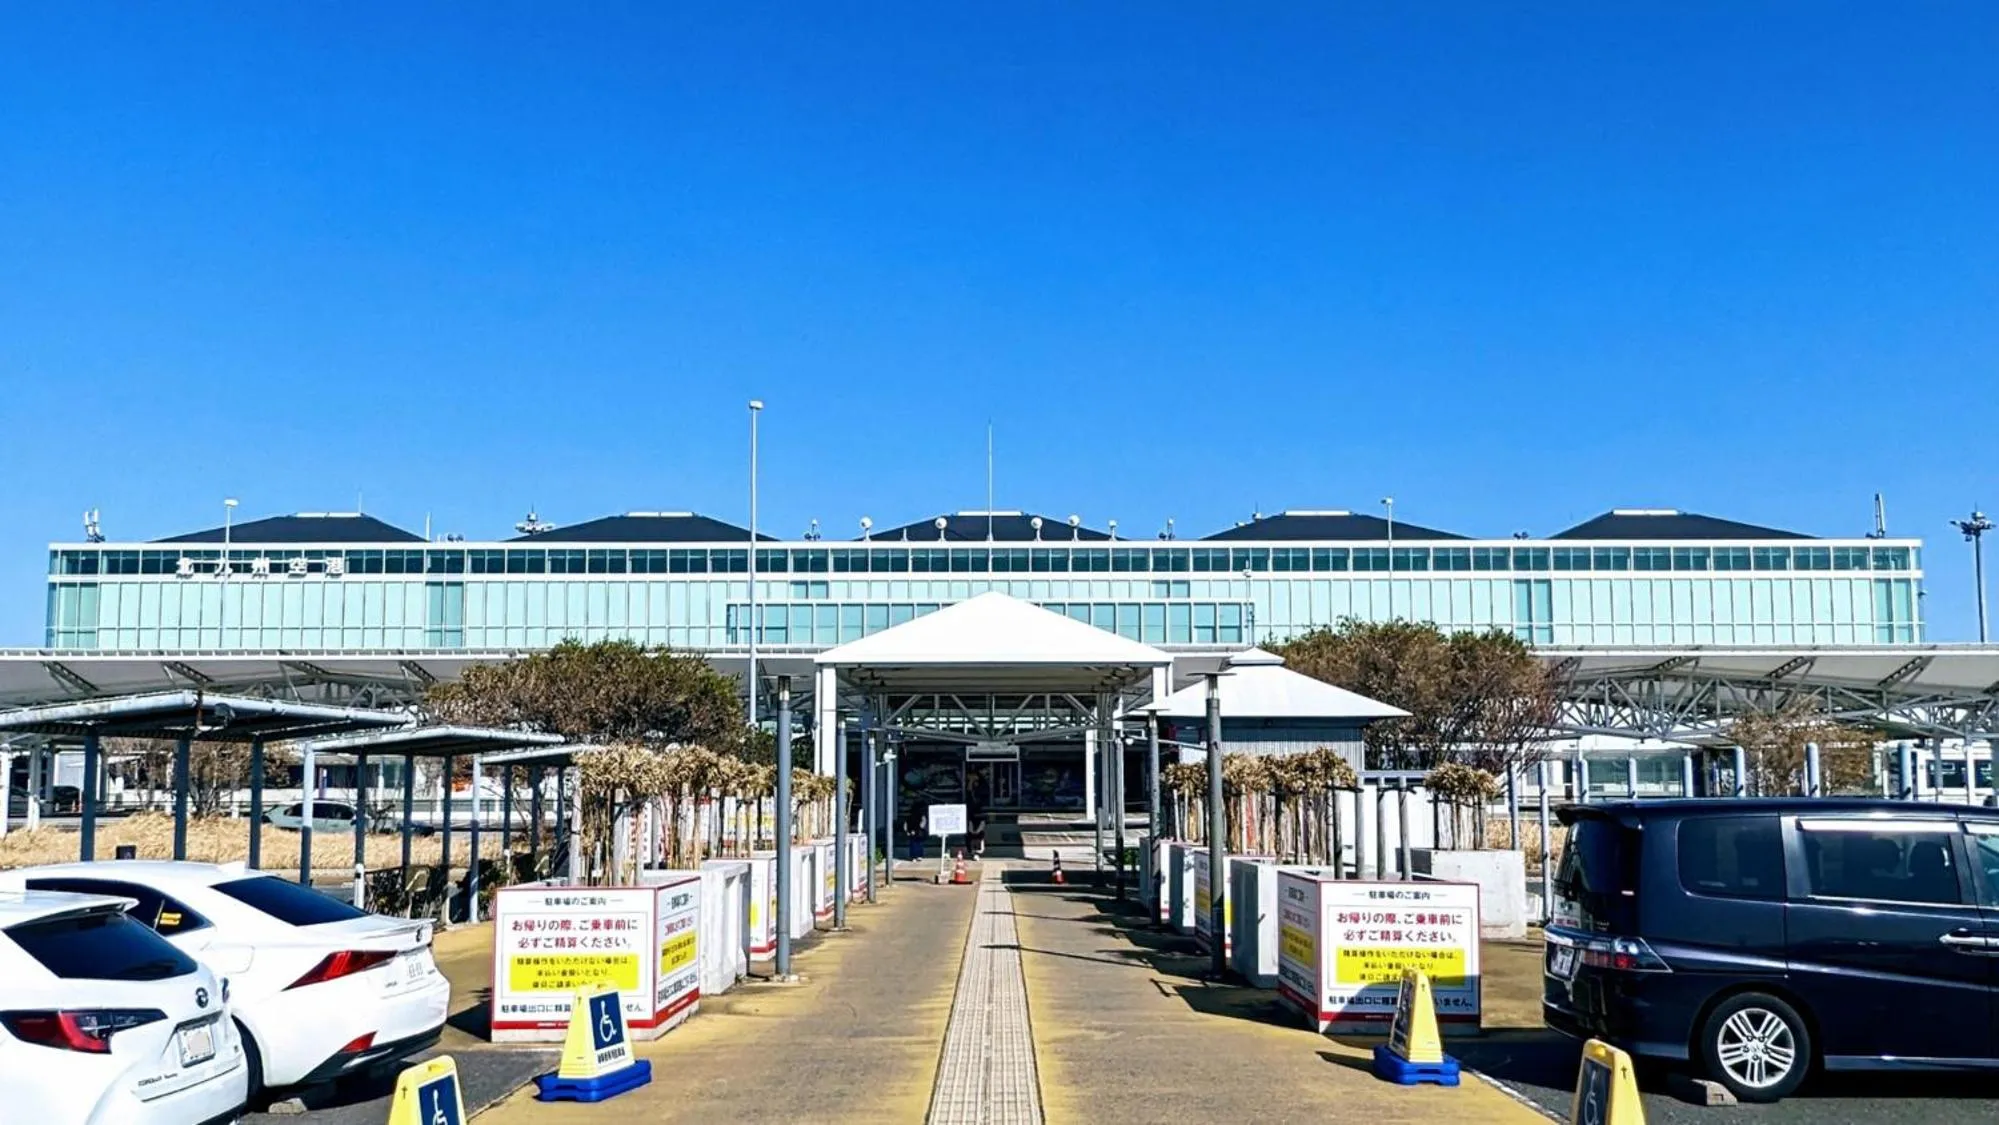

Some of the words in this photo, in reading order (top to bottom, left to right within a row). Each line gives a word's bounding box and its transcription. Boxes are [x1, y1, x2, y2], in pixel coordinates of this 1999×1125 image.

[1368, 891, 1430, 900] 駐車場のご案内
[511, 919, 638, 931] お帰りの際、ご乗車前に
[1336, 912, 1463, 925] お帰りの際、ご乗車前に
[518, 936, 632, 949] 必ずご精算ください。
[1343, 929, 1457, 943] 必ずご精算ください。
